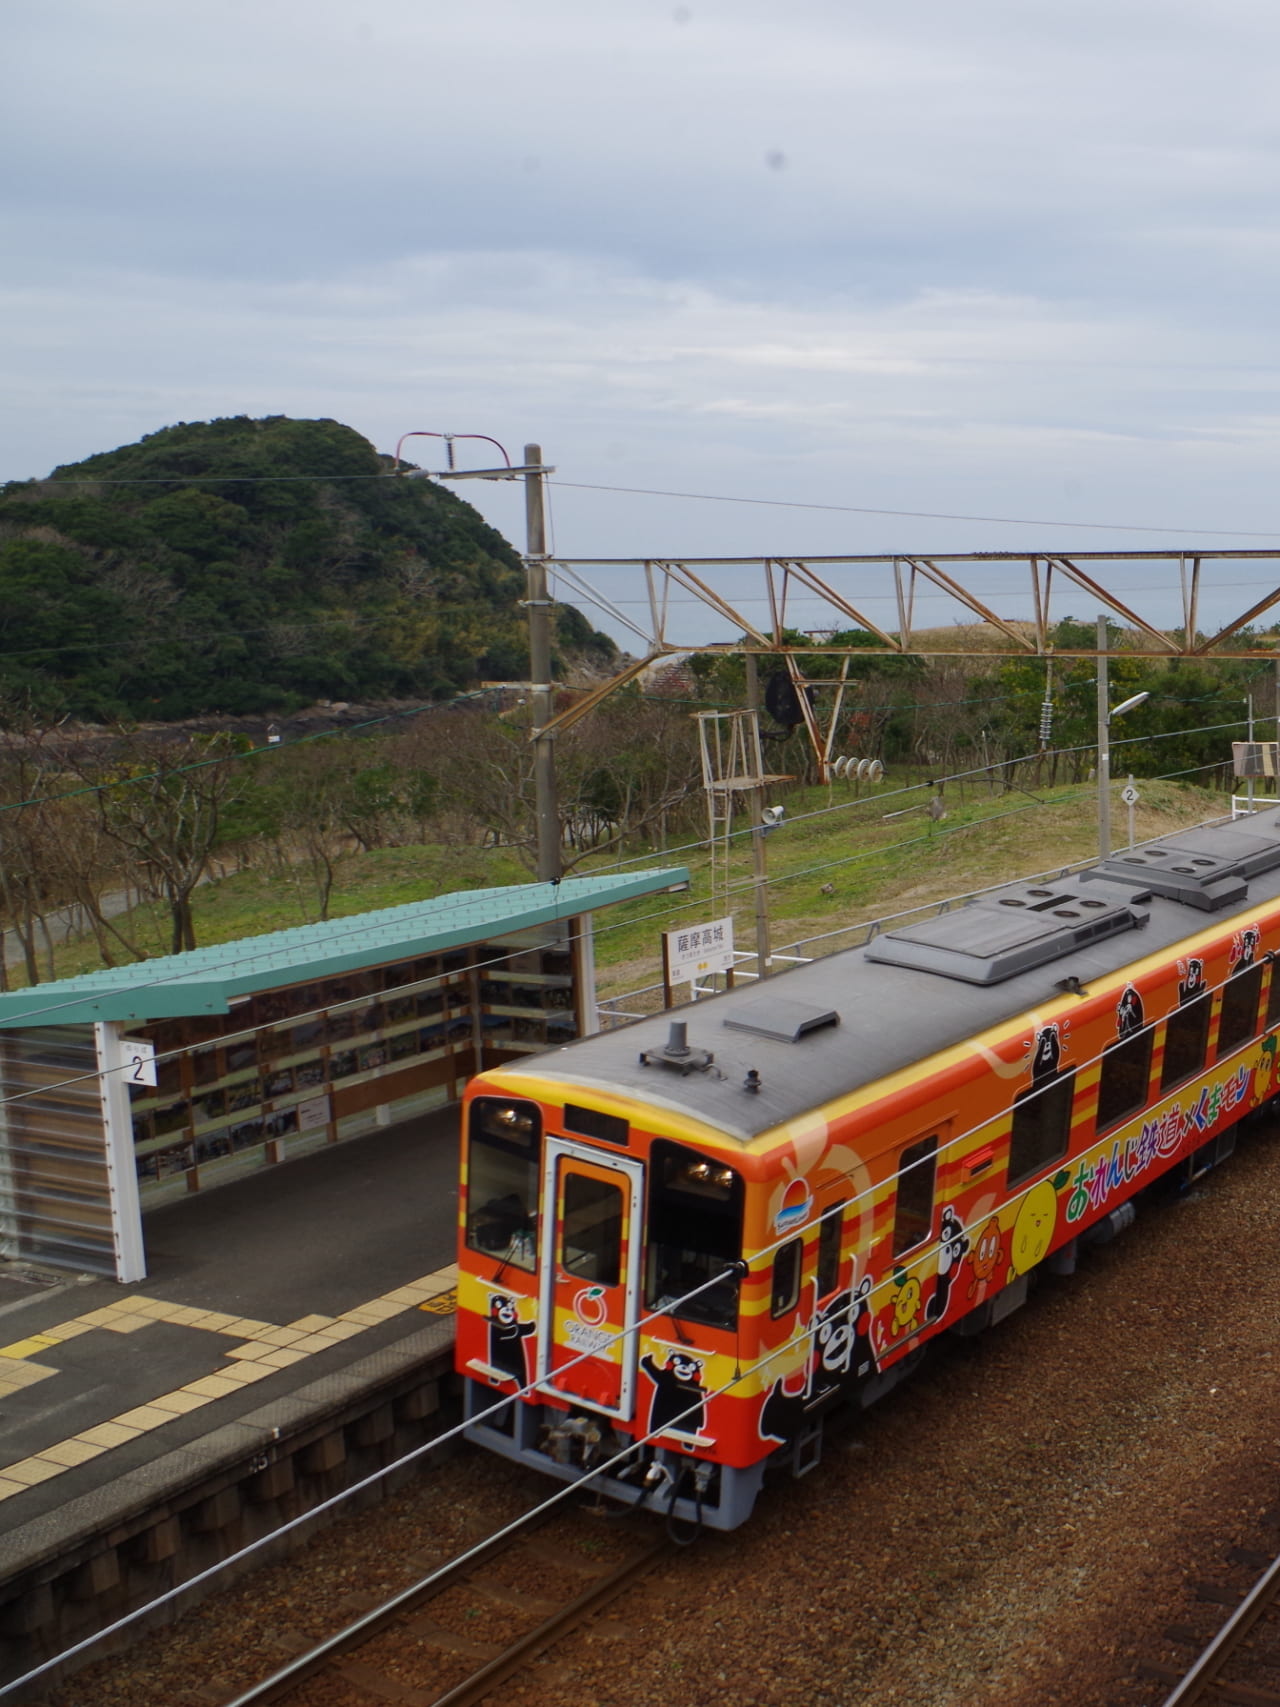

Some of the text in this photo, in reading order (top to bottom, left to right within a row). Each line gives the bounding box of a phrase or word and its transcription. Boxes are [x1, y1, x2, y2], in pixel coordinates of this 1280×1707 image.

[1126, 789, 1134, 801] 2
[677, 924, 724, 952] 薩摩高城
[132, 1055, 145, 1081] 2
